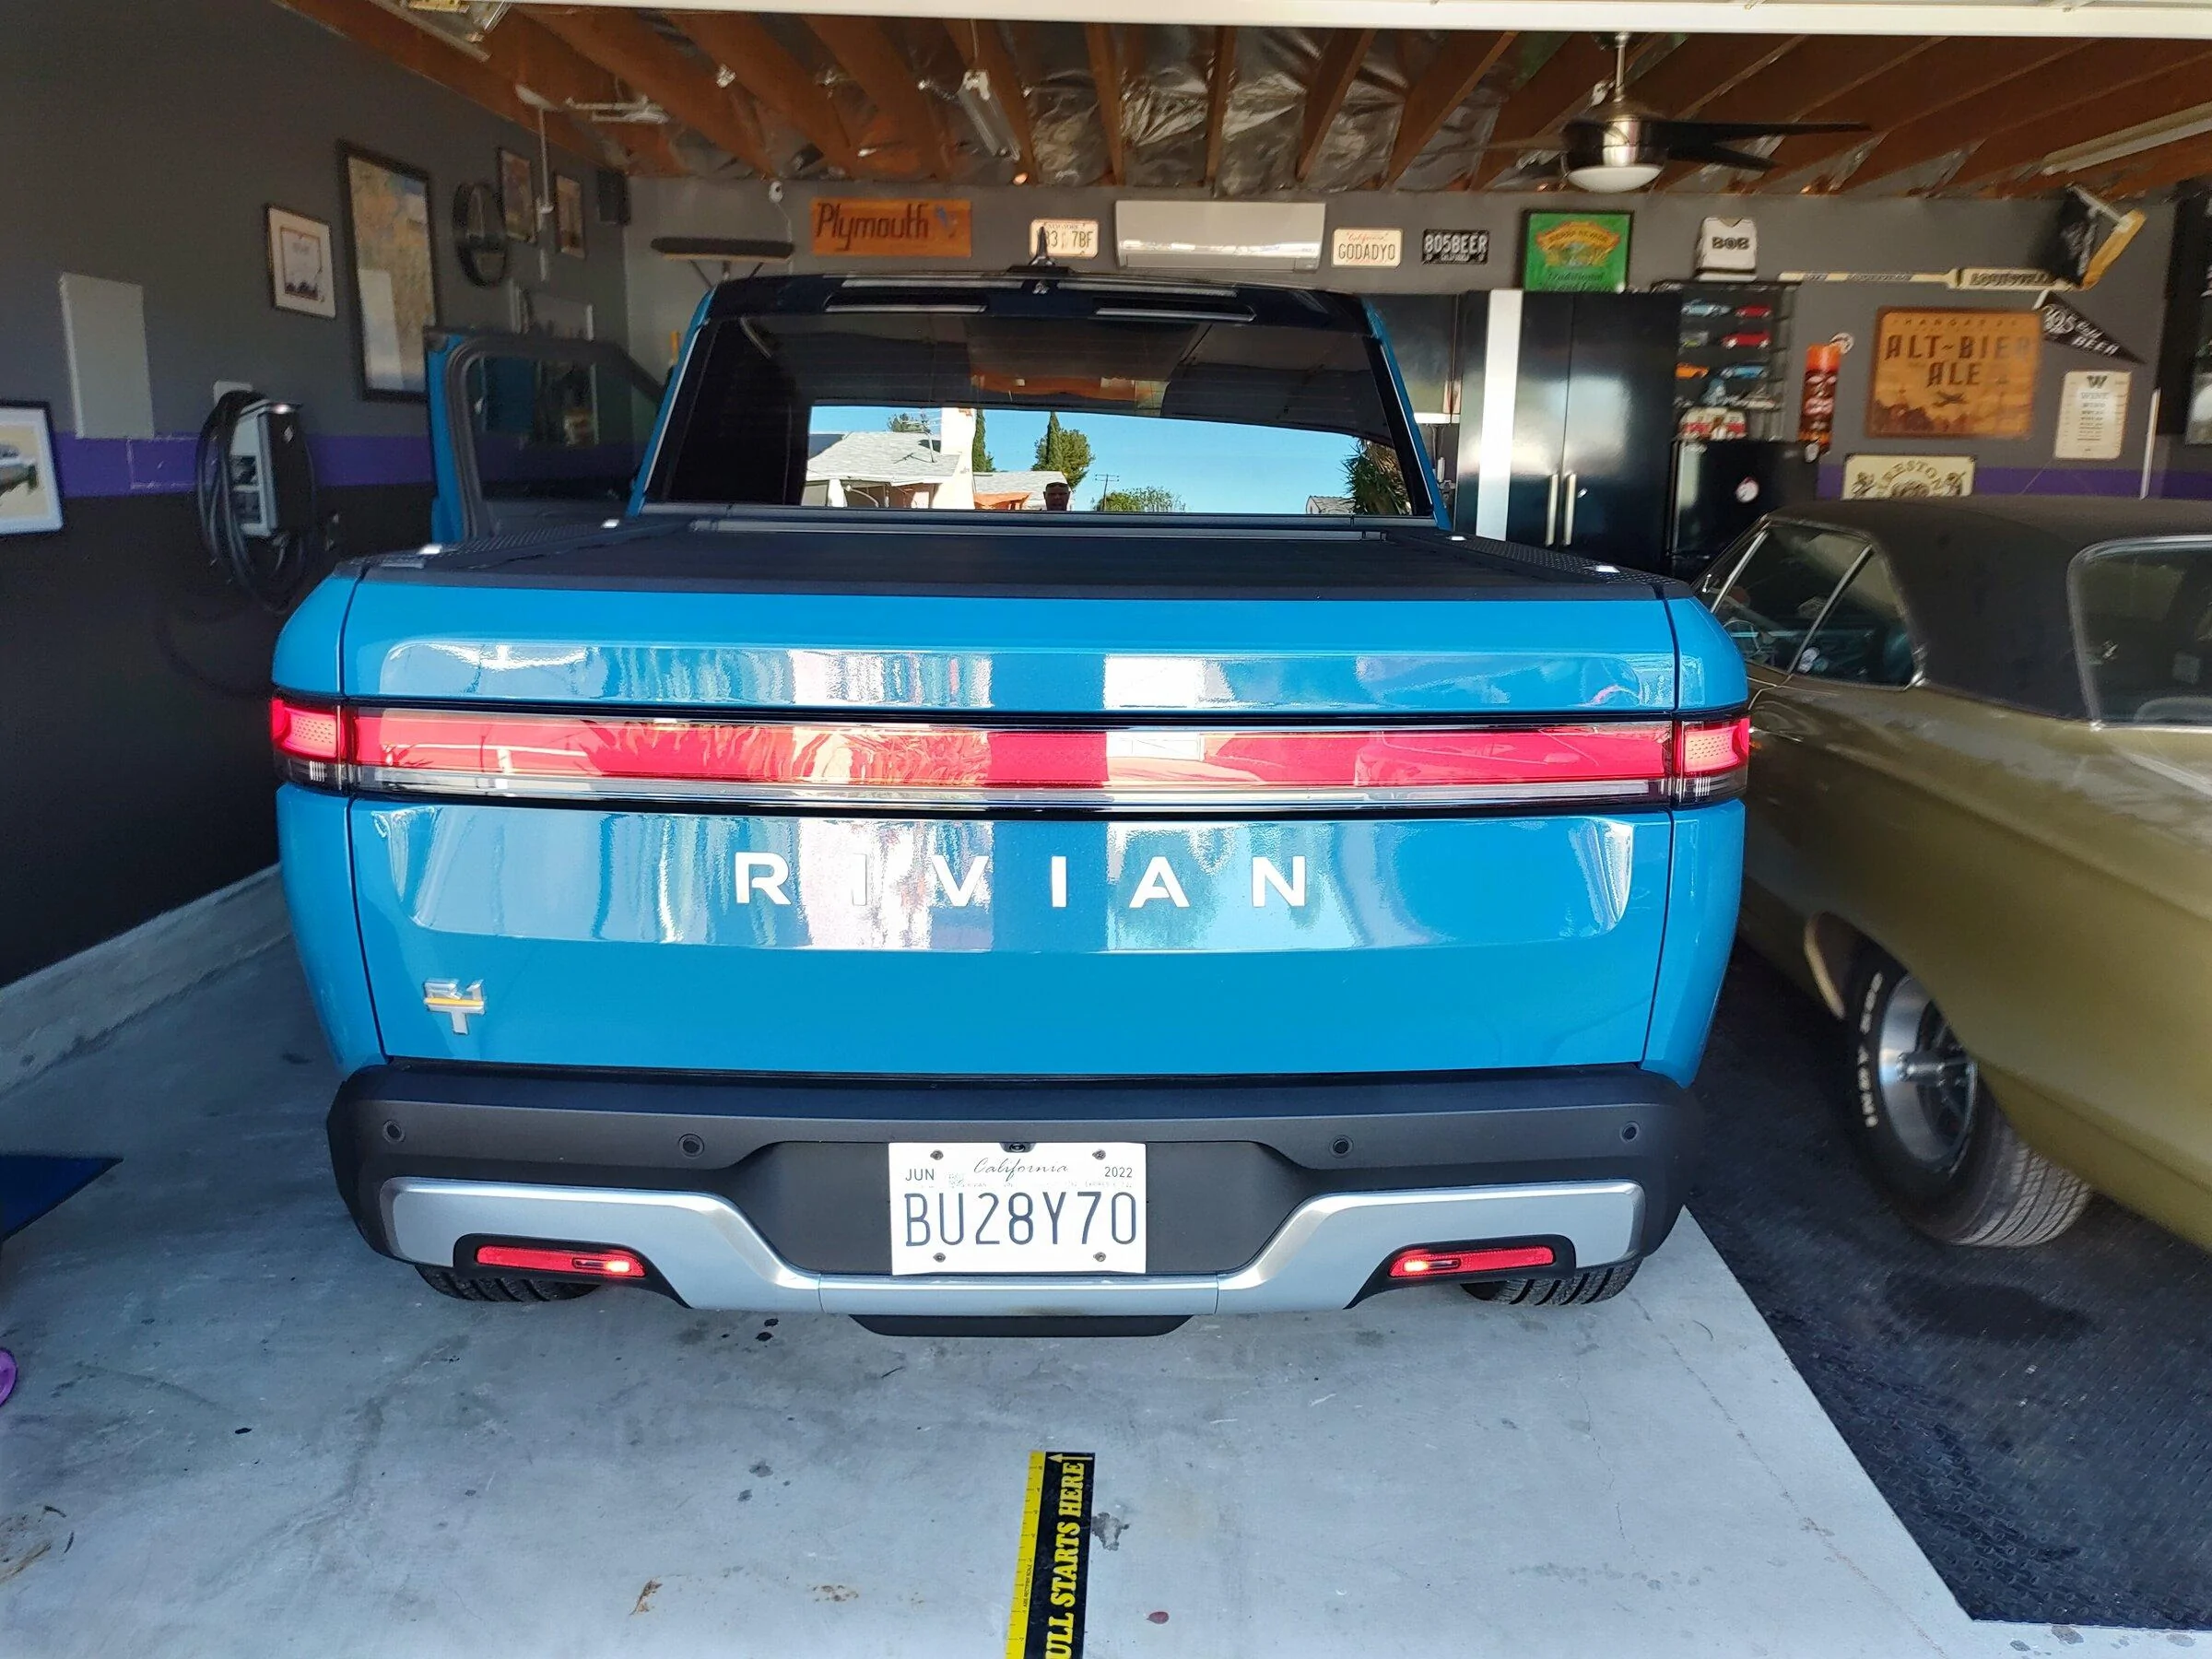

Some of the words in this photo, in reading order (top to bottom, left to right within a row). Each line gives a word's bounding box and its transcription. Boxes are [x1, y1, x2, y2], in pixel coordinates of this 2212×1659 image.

[816, 202, 929, 252] Plymouth
[1424, 233, 1488, 254] 805BEER
[1712, 236, 1750, 250] BOB
[1926, 361, 1983, 388] ALE
[735, 851, 1305, 909] RIVIAN
[905, 1168, 935, 1182] JUN
[1104, 1166, 1134, 1179] 2022
[973, 1158, 1069, 1182] California
[904, 1191, 1137, 1247] BU28Y70
[1058, 1462, 1086, 1518] HERE
[1050, 1521, 1081, 1608] STARTS
